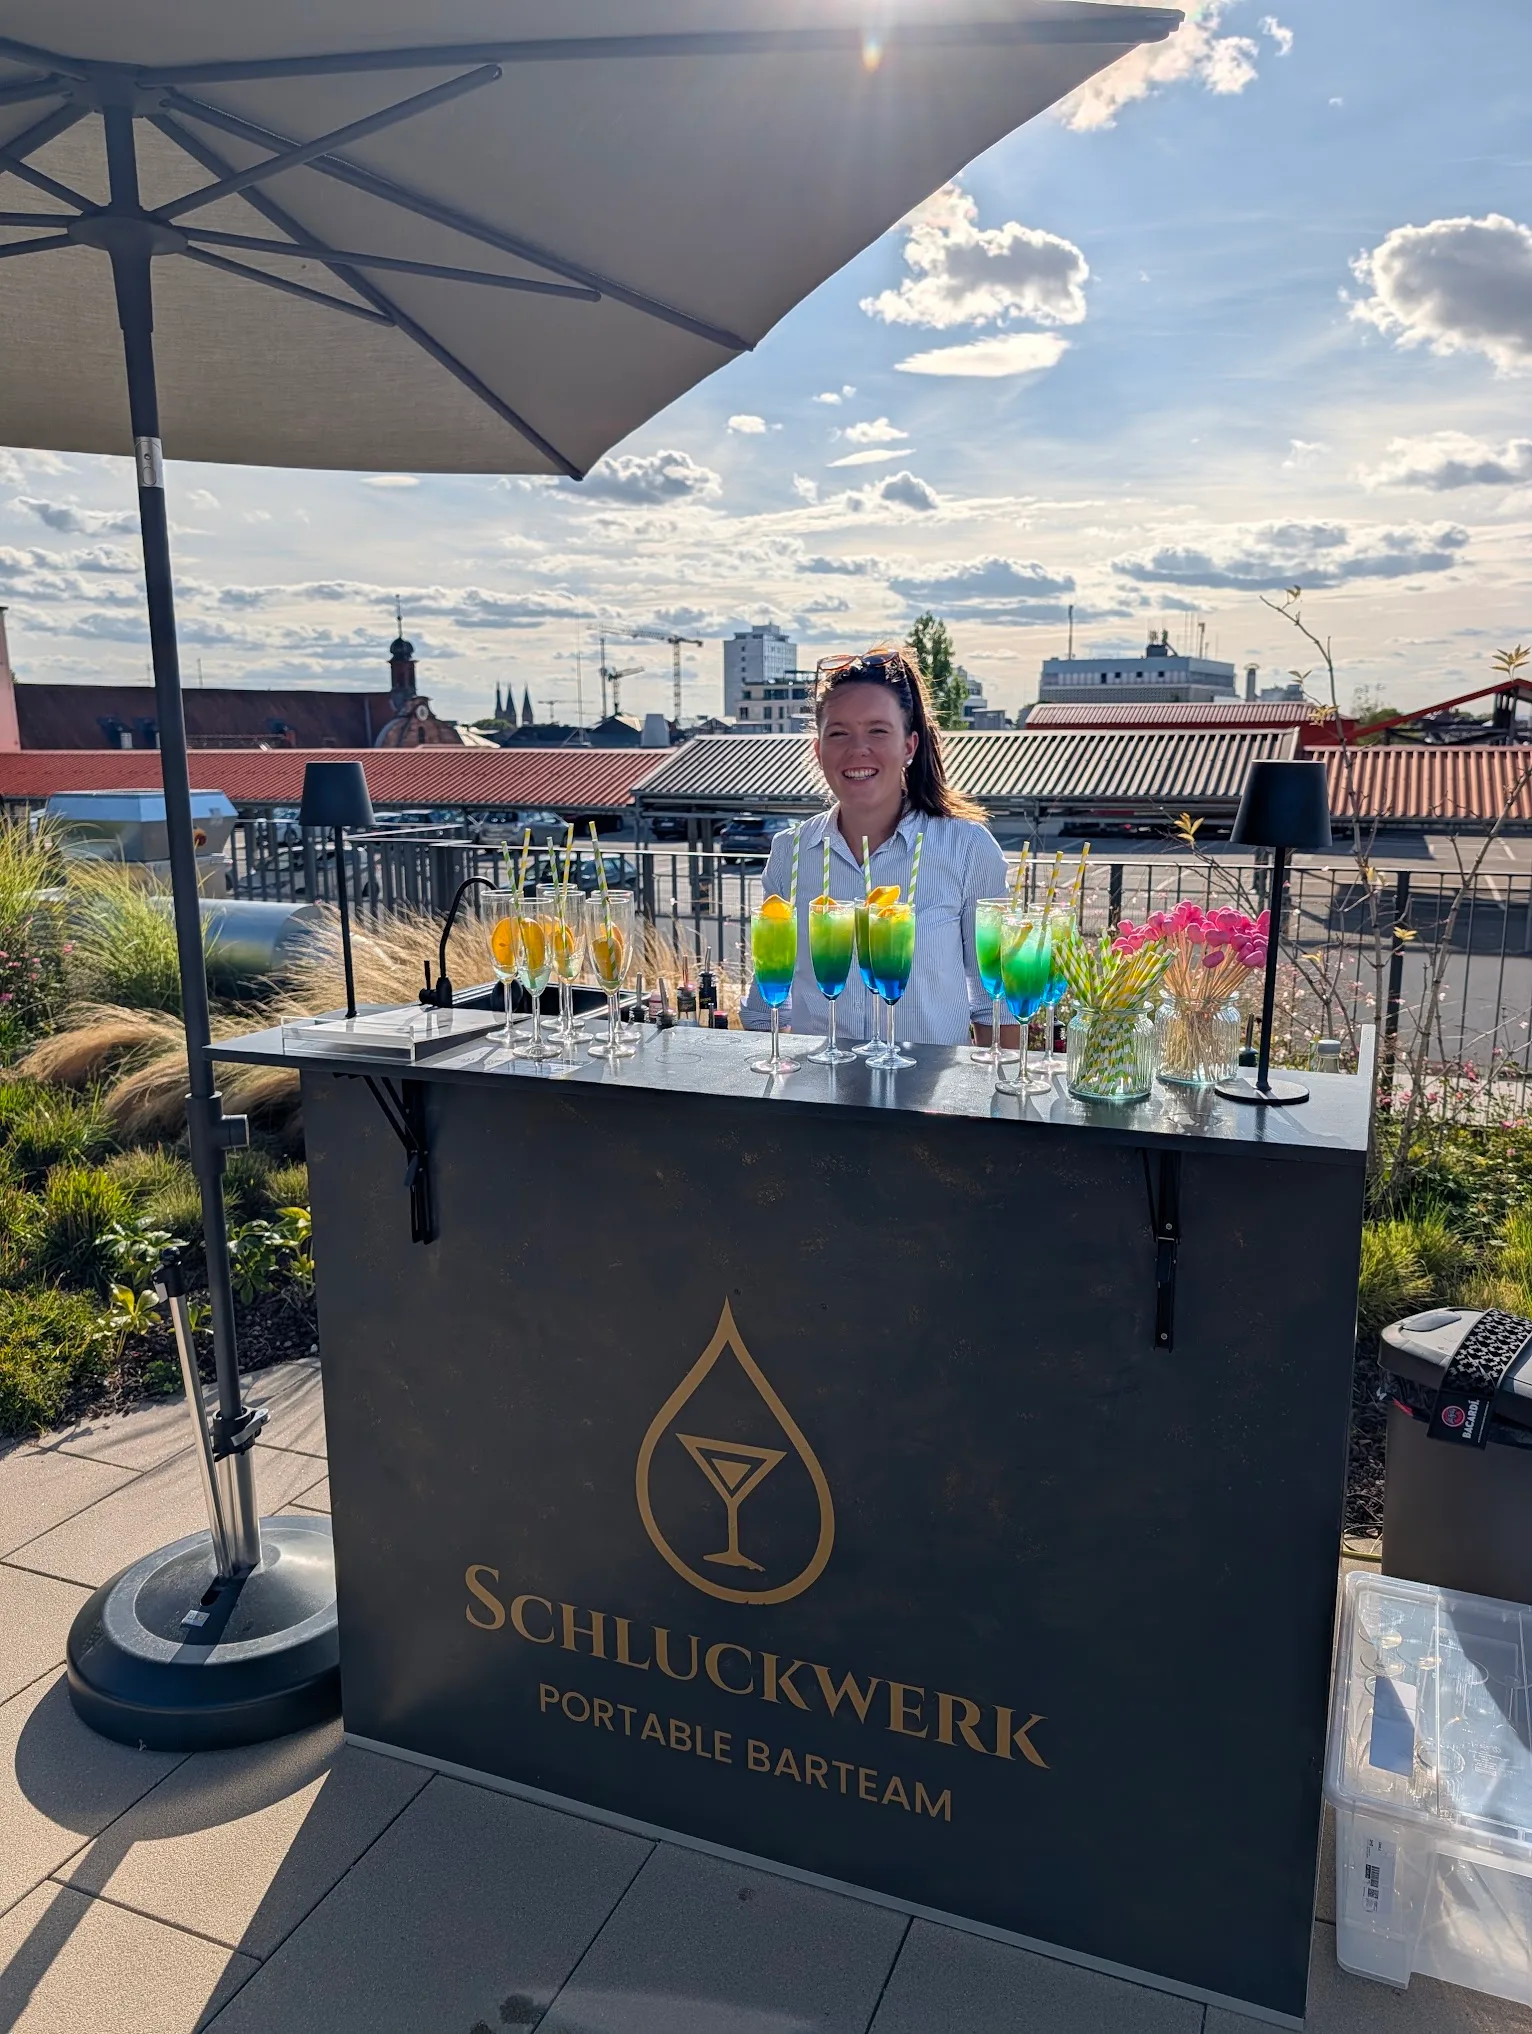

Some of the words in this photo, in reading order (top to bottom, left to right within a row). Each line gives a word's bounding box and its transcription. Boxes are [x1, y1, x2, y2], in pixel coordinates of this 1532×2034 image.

[464, 1564, 1051, 1769] SCHLUCKWERK
[539, 1683, 733, 1764] PORTABLE
[747, 1739, 953, 1822] BARTEAM
